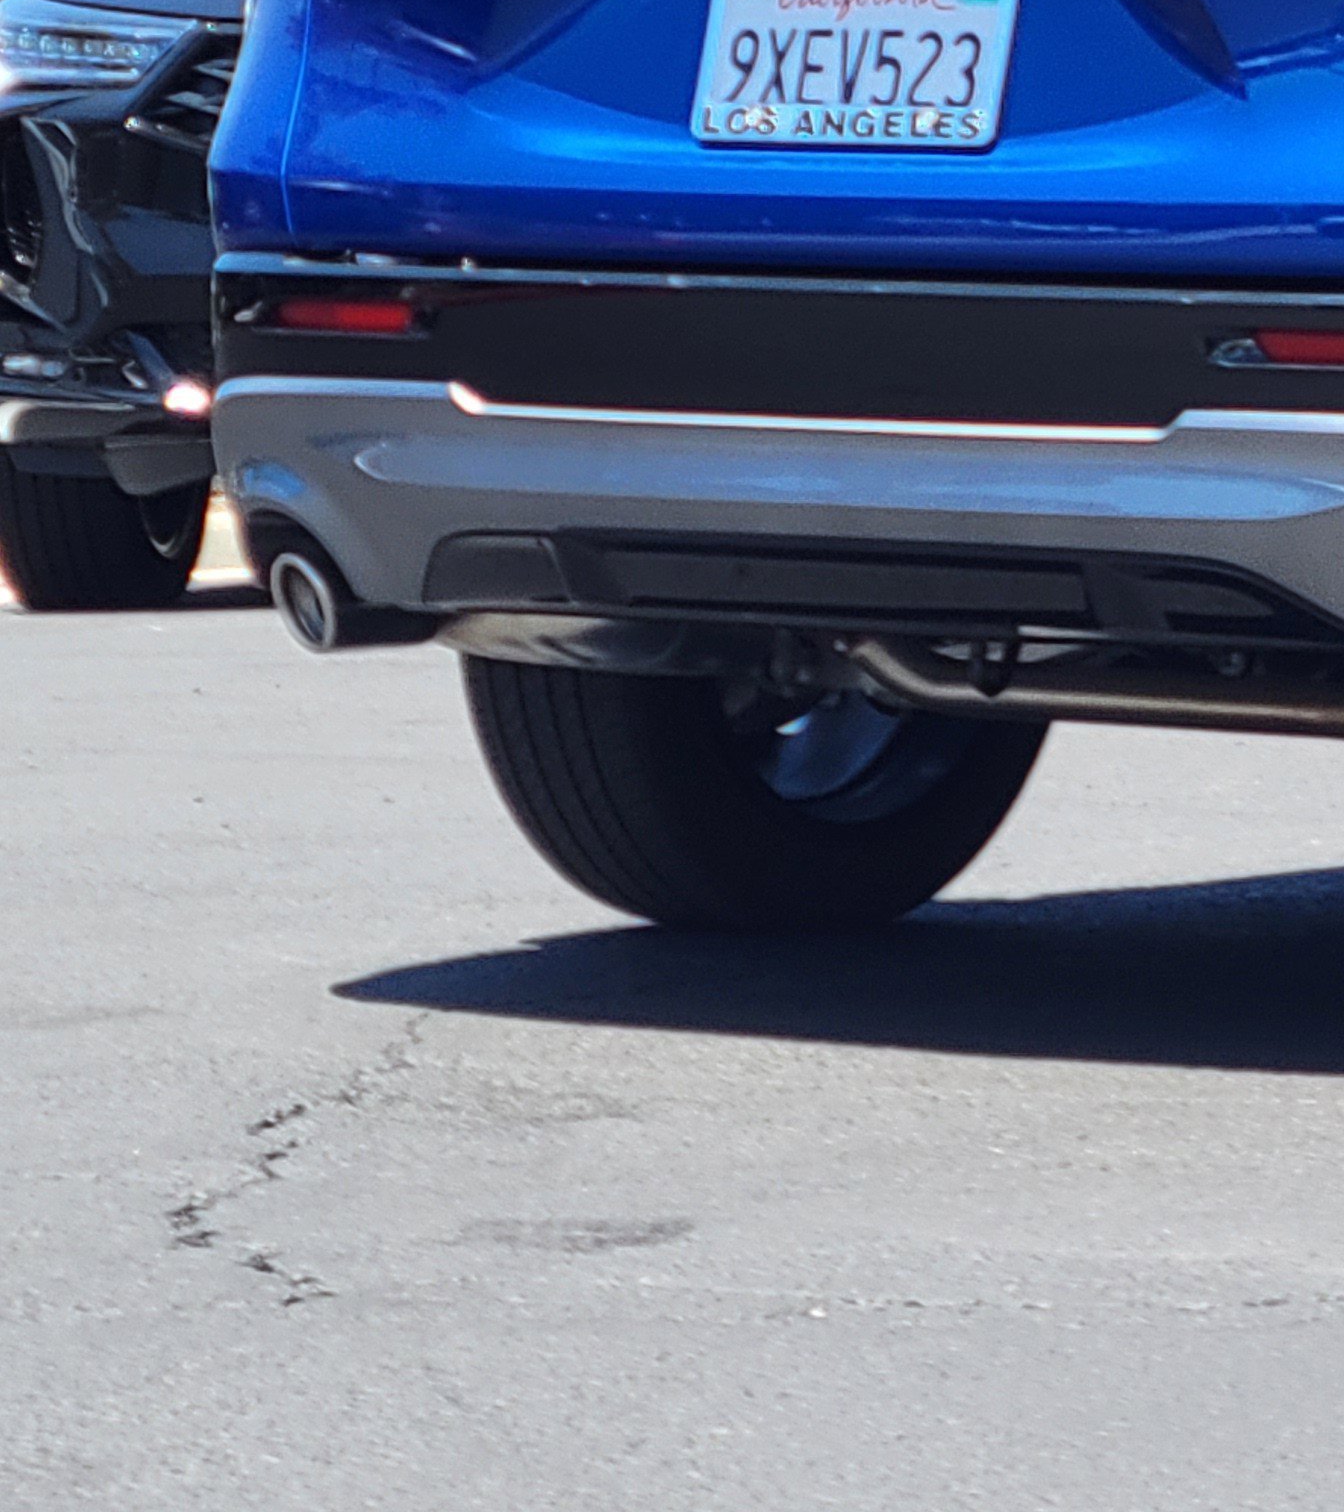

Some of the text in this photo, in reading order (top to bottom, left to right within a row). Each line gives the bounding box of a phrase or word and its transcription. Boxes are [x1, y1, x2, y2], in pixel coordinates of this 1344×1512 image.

[726, 28, 982, 108] 9XEV523
[702, 107, 981, 139] LOS ANGELES
